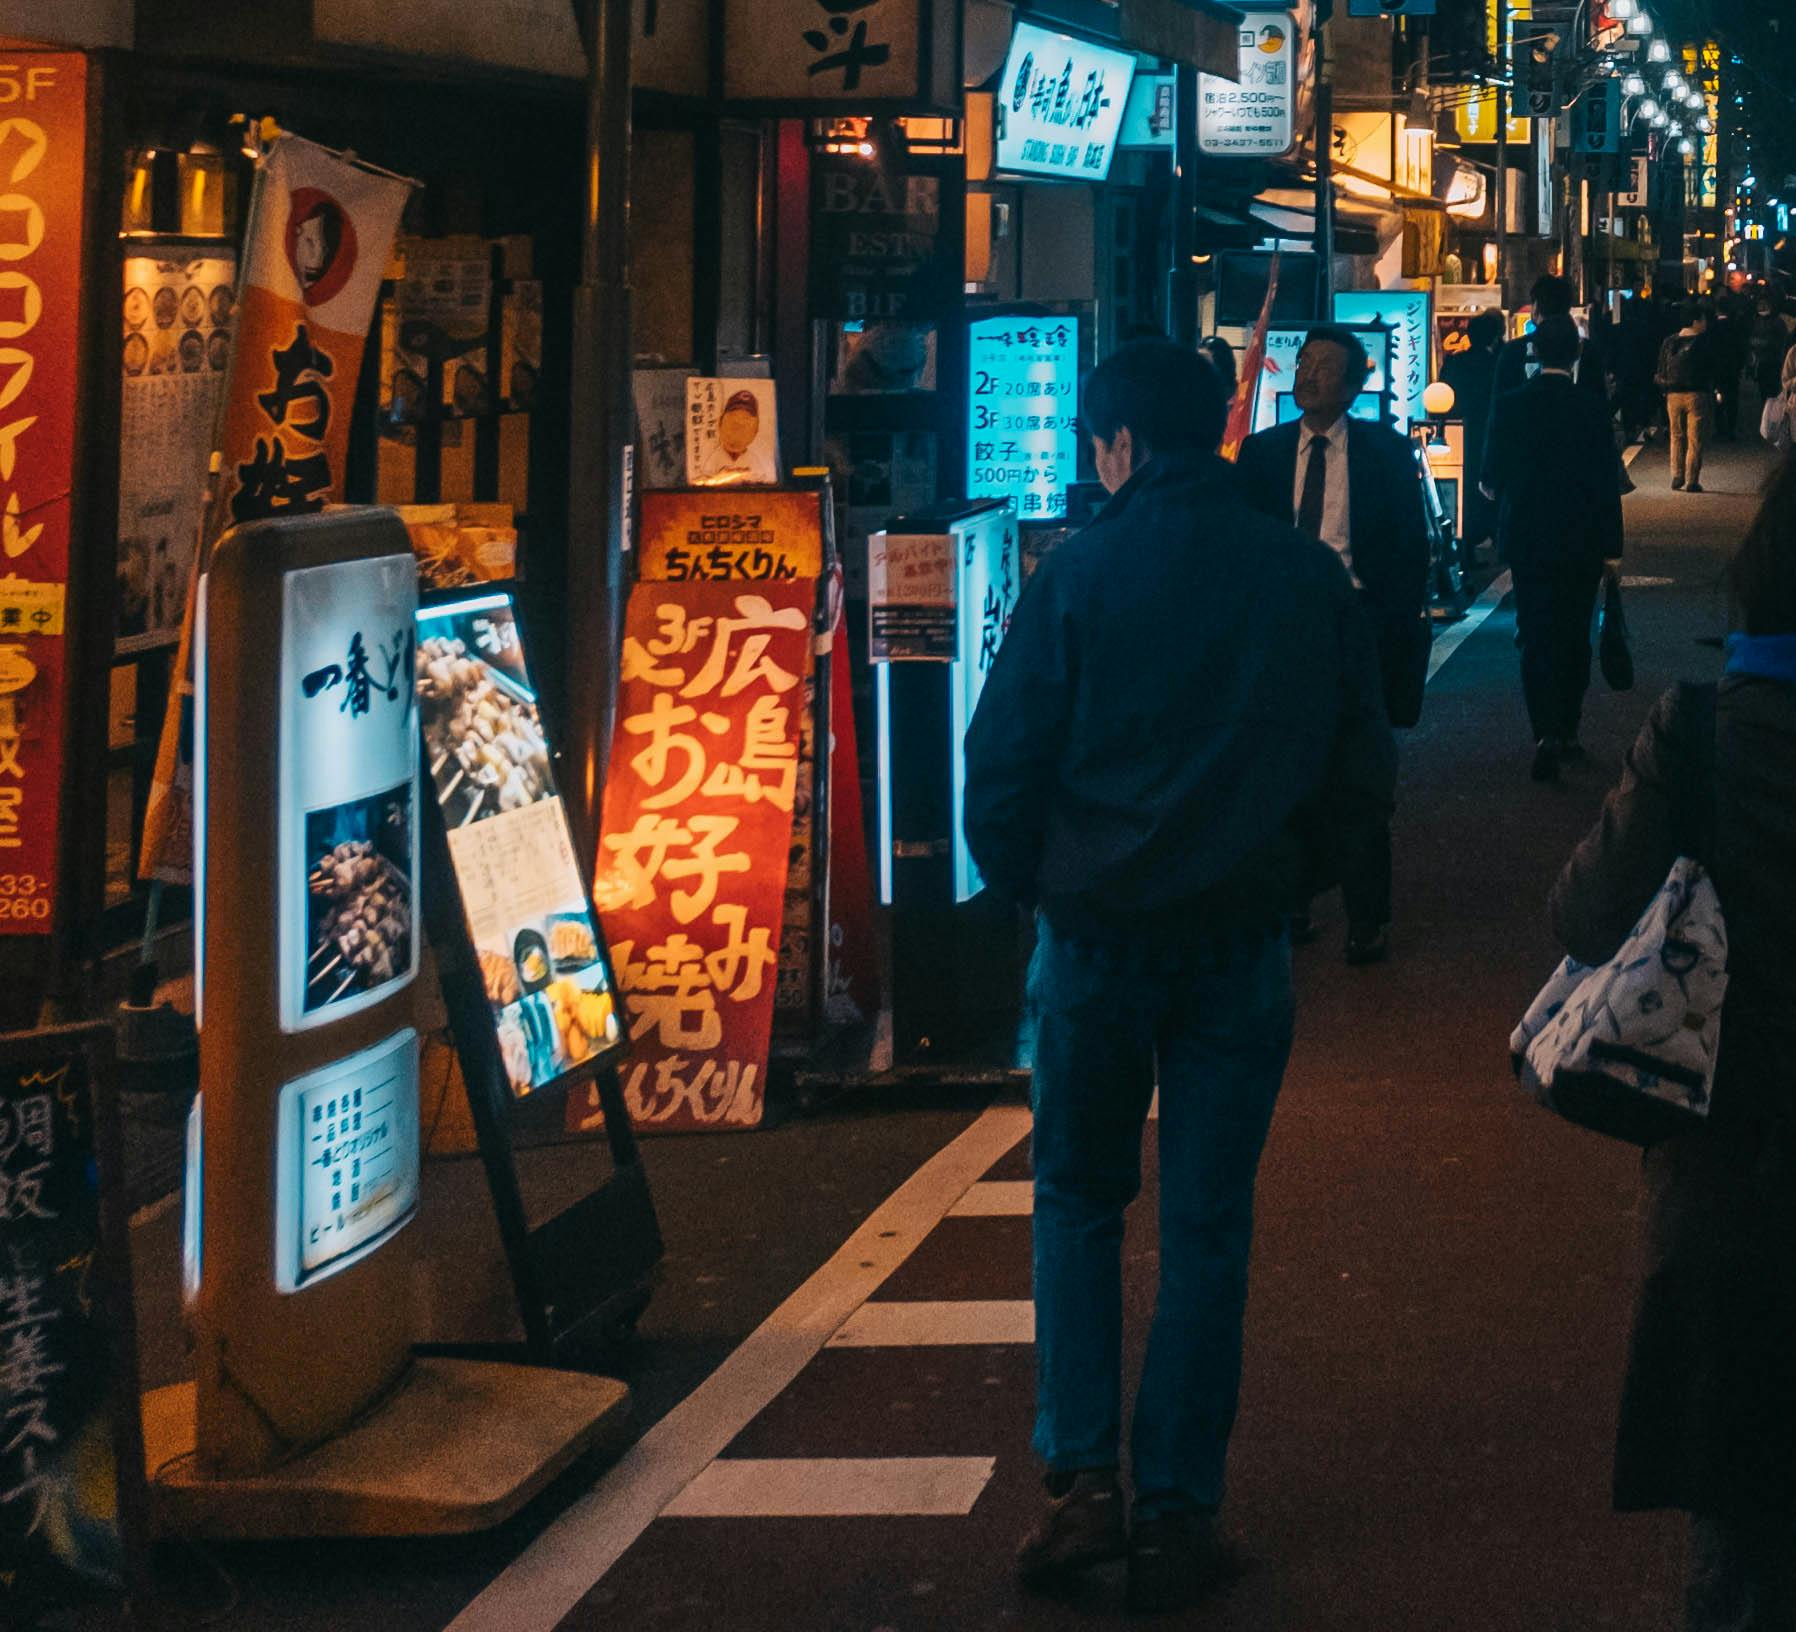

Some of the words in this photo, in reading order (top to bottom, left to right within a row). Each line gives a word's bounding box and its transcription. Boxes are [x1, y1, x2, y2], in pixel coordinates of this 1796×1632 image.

[822, 172, 940, 214] BAR
[1405, 300, 1424, 403] ジンギスカン
[974, 370, 999, 396] 2F
[1004, 381, 1072, 396] 20席あり
[974, 404, 999, 430] 3F
[1004, 415, 1072, 431] 30席あり
[974, 441, 1019, 462] 餃子
[973, 467, 1058, 484] 500円から
[978, 494, 1068, 512] 肉串焼
[700, 513, 763, 530] ヒロシマ
[665, 546, 797, 583] ちんちくりん
[647, 603, 714, 656] 3F
[678, 594, 807, 812] 広島
